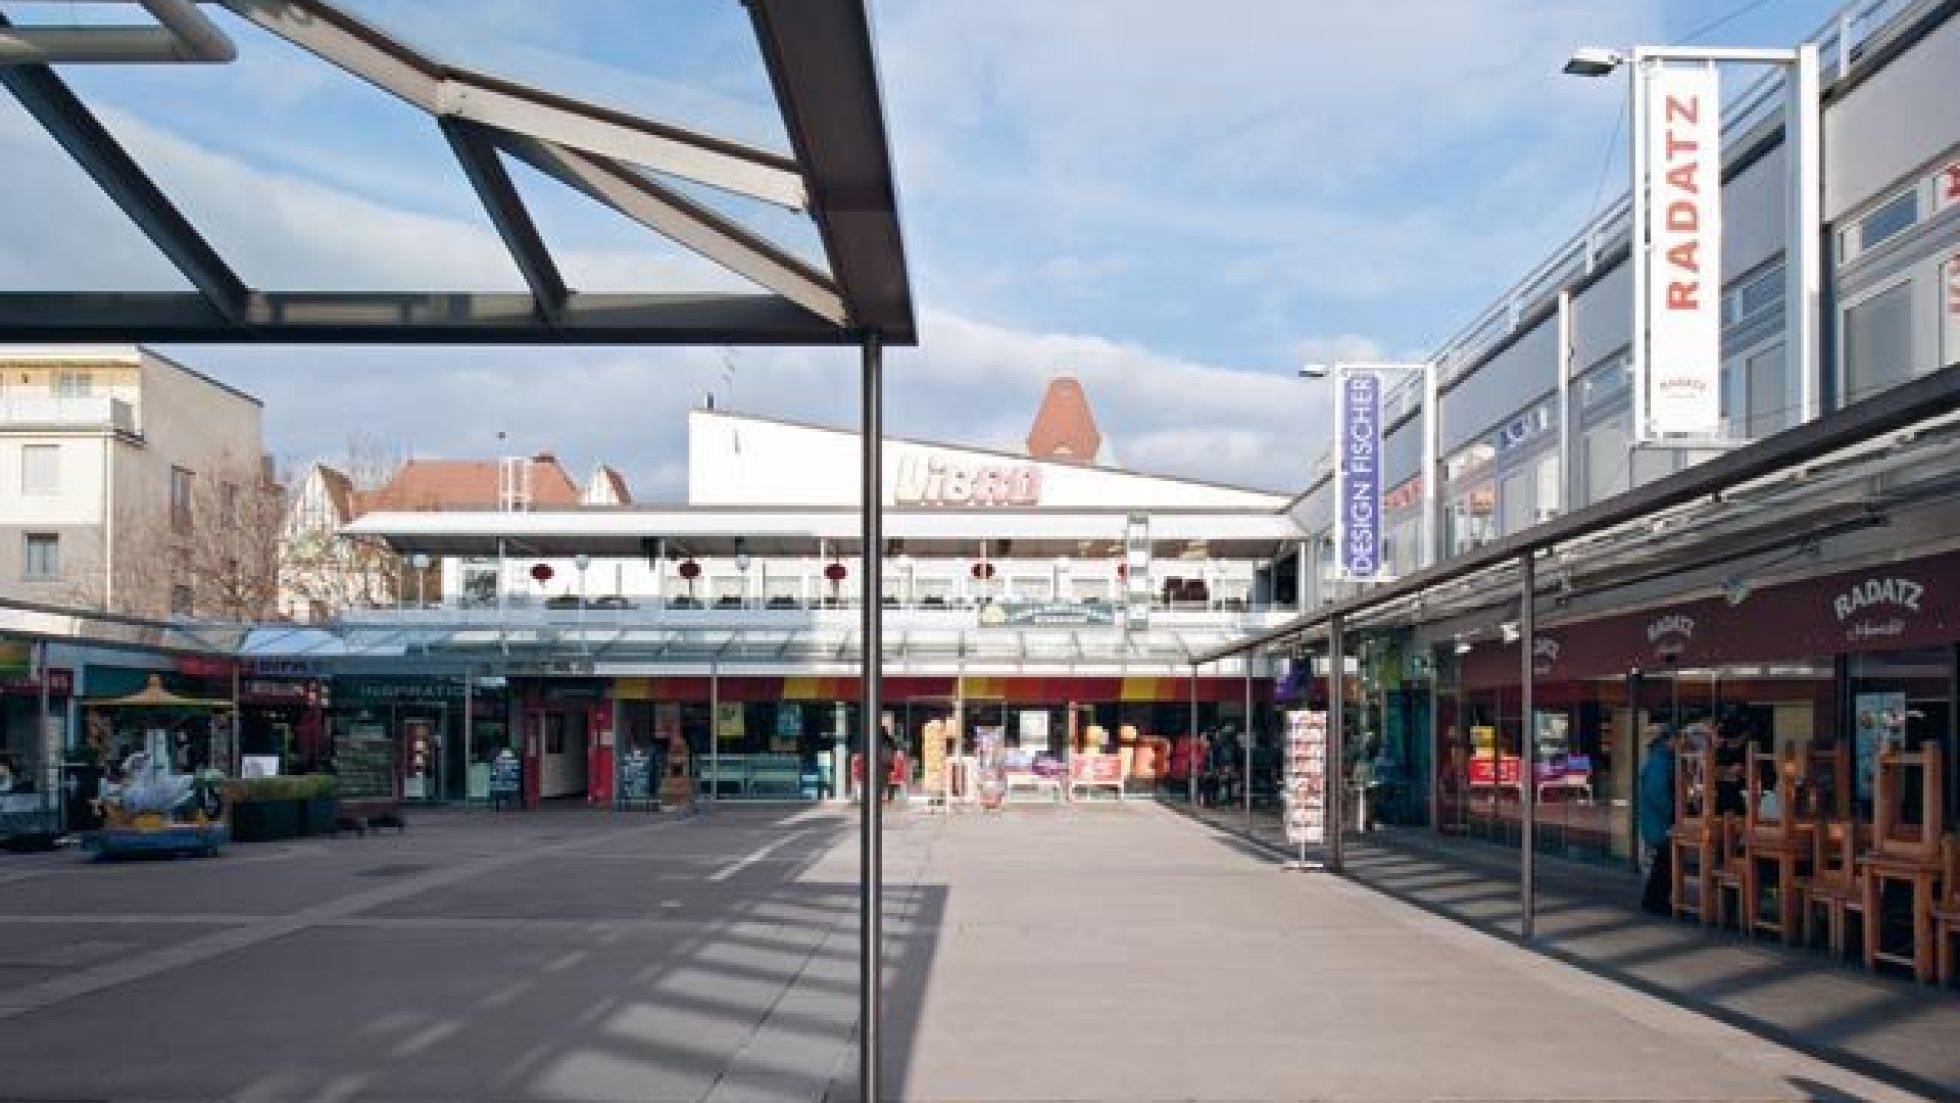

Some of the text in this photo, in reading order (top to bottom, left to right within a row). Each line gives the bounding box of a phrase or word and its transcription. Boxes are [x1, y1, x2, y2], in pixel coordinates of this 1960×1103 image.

[1665, 94, 1700, 310] RADATZ
[1352, 378, 1374, 571] DESIGN FISCHER
[1833, 577, 1924, 620] RADATZ
